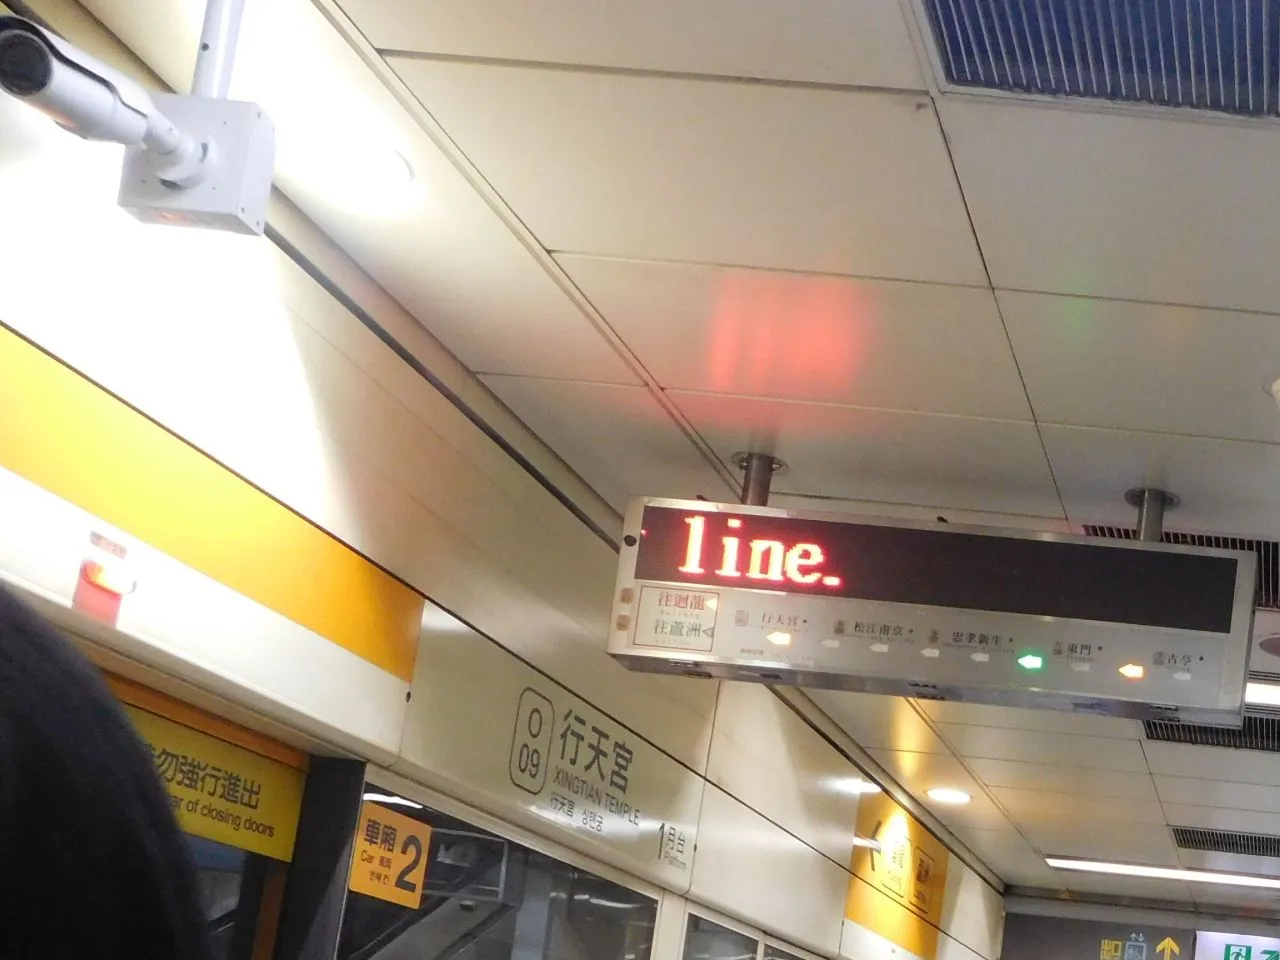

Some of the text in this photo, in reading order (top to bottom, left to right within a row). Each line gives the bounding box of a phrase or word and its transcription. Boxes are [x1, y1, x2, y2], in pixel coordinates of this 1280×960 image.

[678, 514, 842, 588] line.
[155, 747, 262, 811] 勿強行進出
[518, 743, 541, 779] 09
[560, 708, 634, 795] 行天宮
[186, 798, 199, 813] of
[200, 803, 241, 831] closing
[243, 815, 276, 838] doors
[552, 764, 641, 827] XINGTIAN TEMPLE
[364, 818, 397, 853] 車廂
[394, 834, 423, 893] 2
